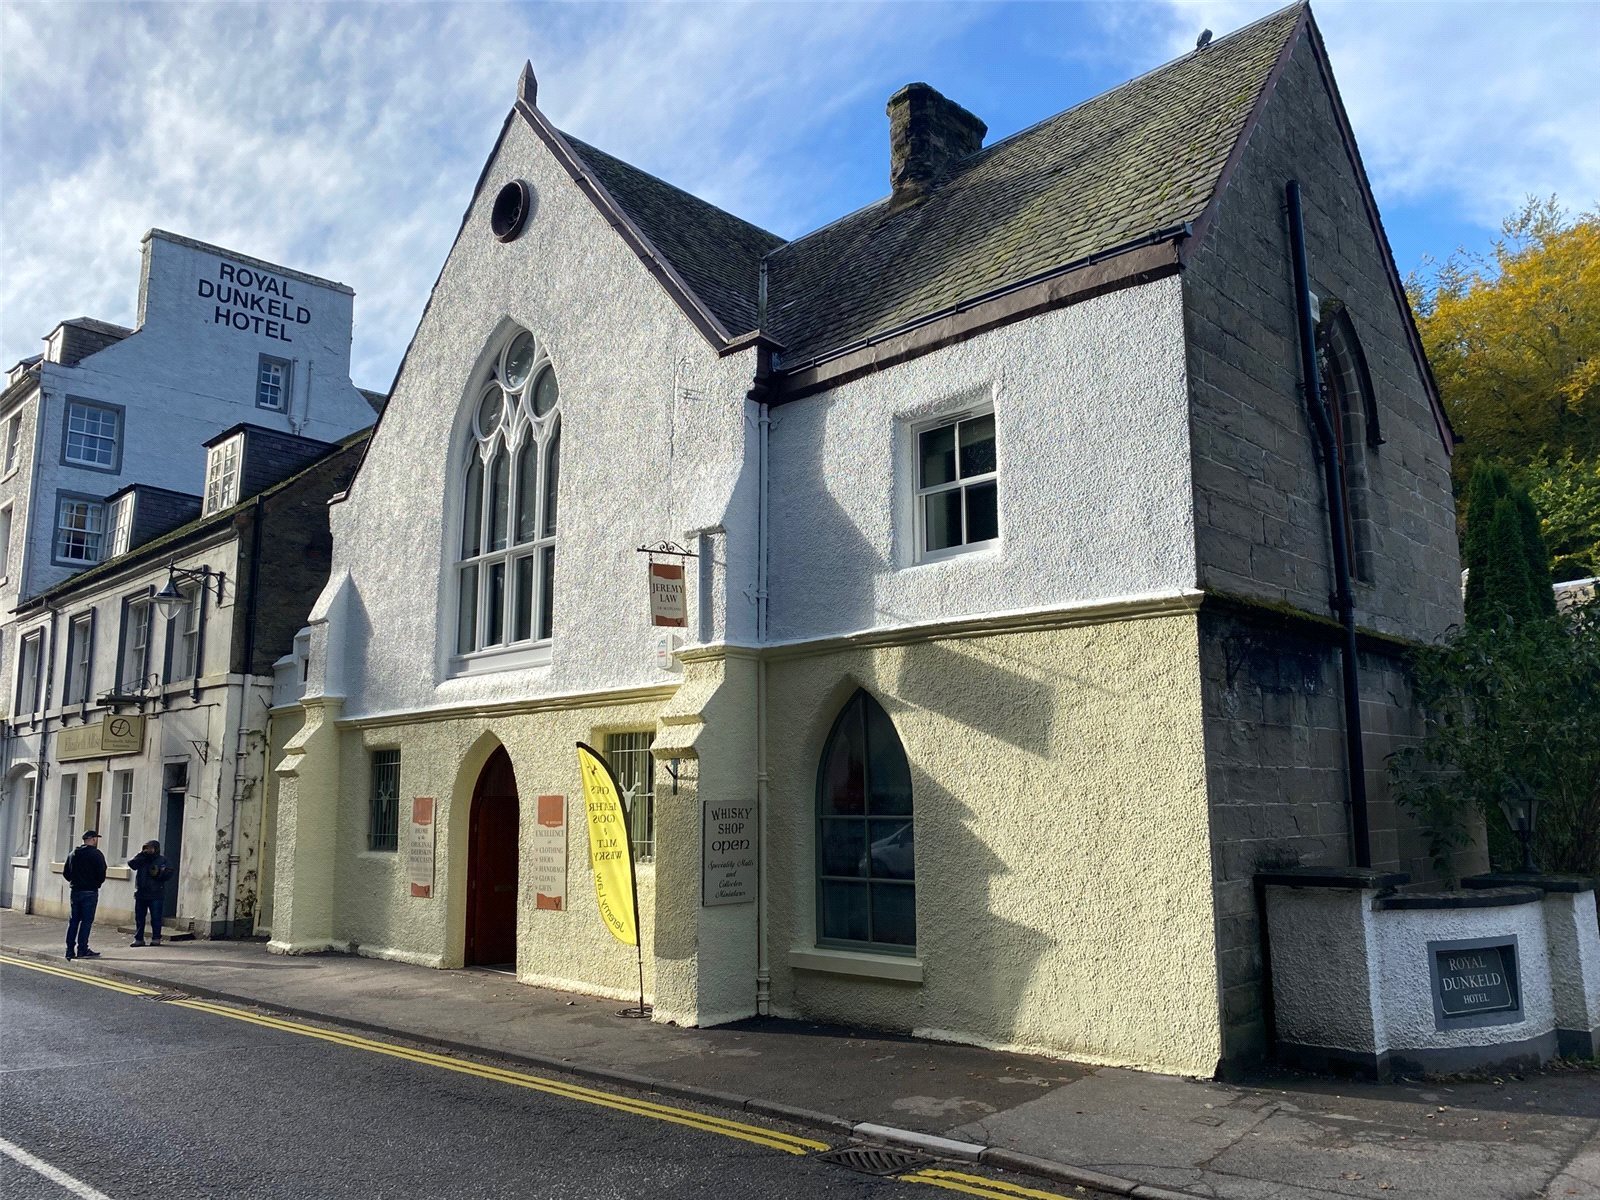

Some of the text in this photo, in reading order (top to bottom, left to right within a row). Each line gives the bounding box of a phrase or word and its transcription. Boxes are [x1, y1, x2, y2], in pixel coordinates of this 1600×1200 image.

[220, 263, 294, 299] ROYAL
[198, 279, 311, 324] DUNKELD
[215, 306, 293, 342] HOTEL
[652, 583, 684, 594] JEREMY
[660, 594, 678, 602] LAW
[711, 807, 752, 820] WHISKY
[718, 822, 744, 834] SHOP
[711, 838, 750, 854] open
[1448, 956, 1487, 971] ROYAL
[1442, 972, 1501, 991] DUNKELD
[1463, 993, 1490, 1004] HOTEL
